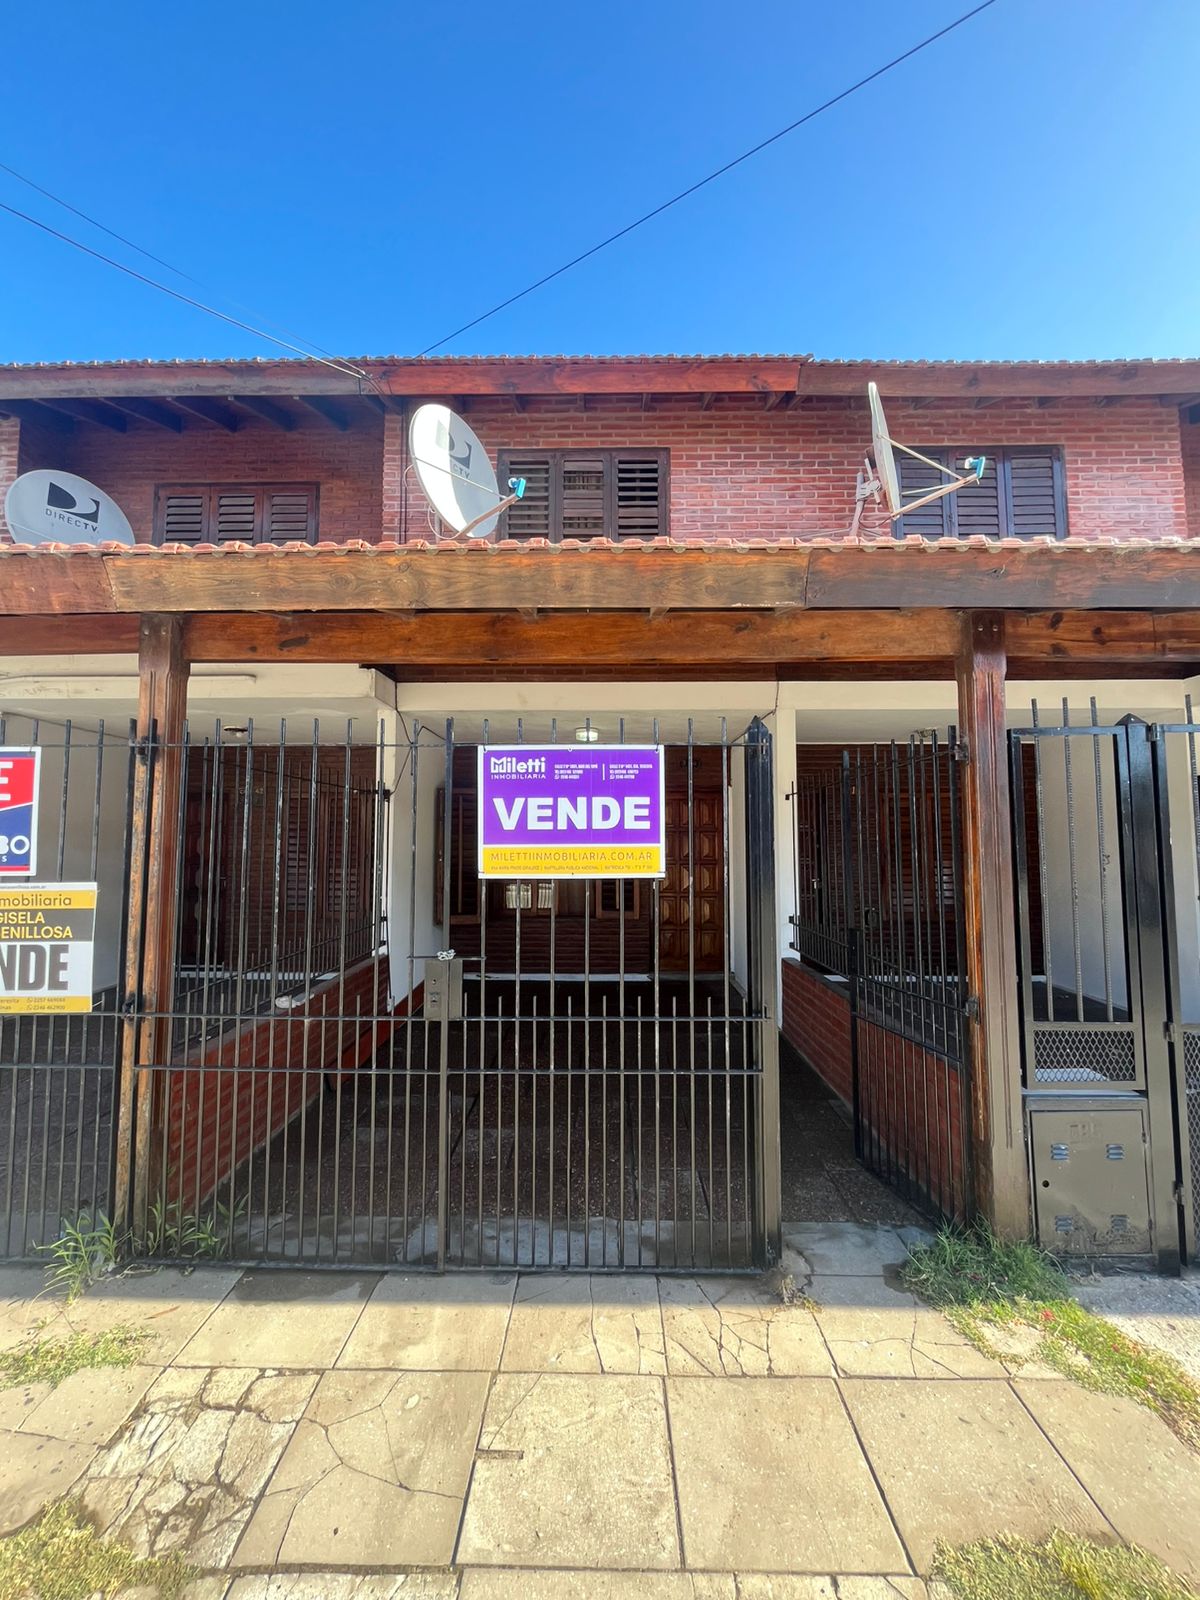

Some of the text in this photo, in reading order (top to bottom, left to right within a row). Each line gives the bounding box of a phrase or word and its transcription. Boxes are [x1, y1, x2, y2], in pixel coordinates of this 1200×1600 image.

[45, 508, 98, 532] DIRECTV
[490, 756, 546, 773] Miletti
[493, 796, 651, 831] VENDE
[490, 852, 653, 862] MILETTIINMOBILIARIA.COM.AR
[0, 944, 69, 991] NDE
